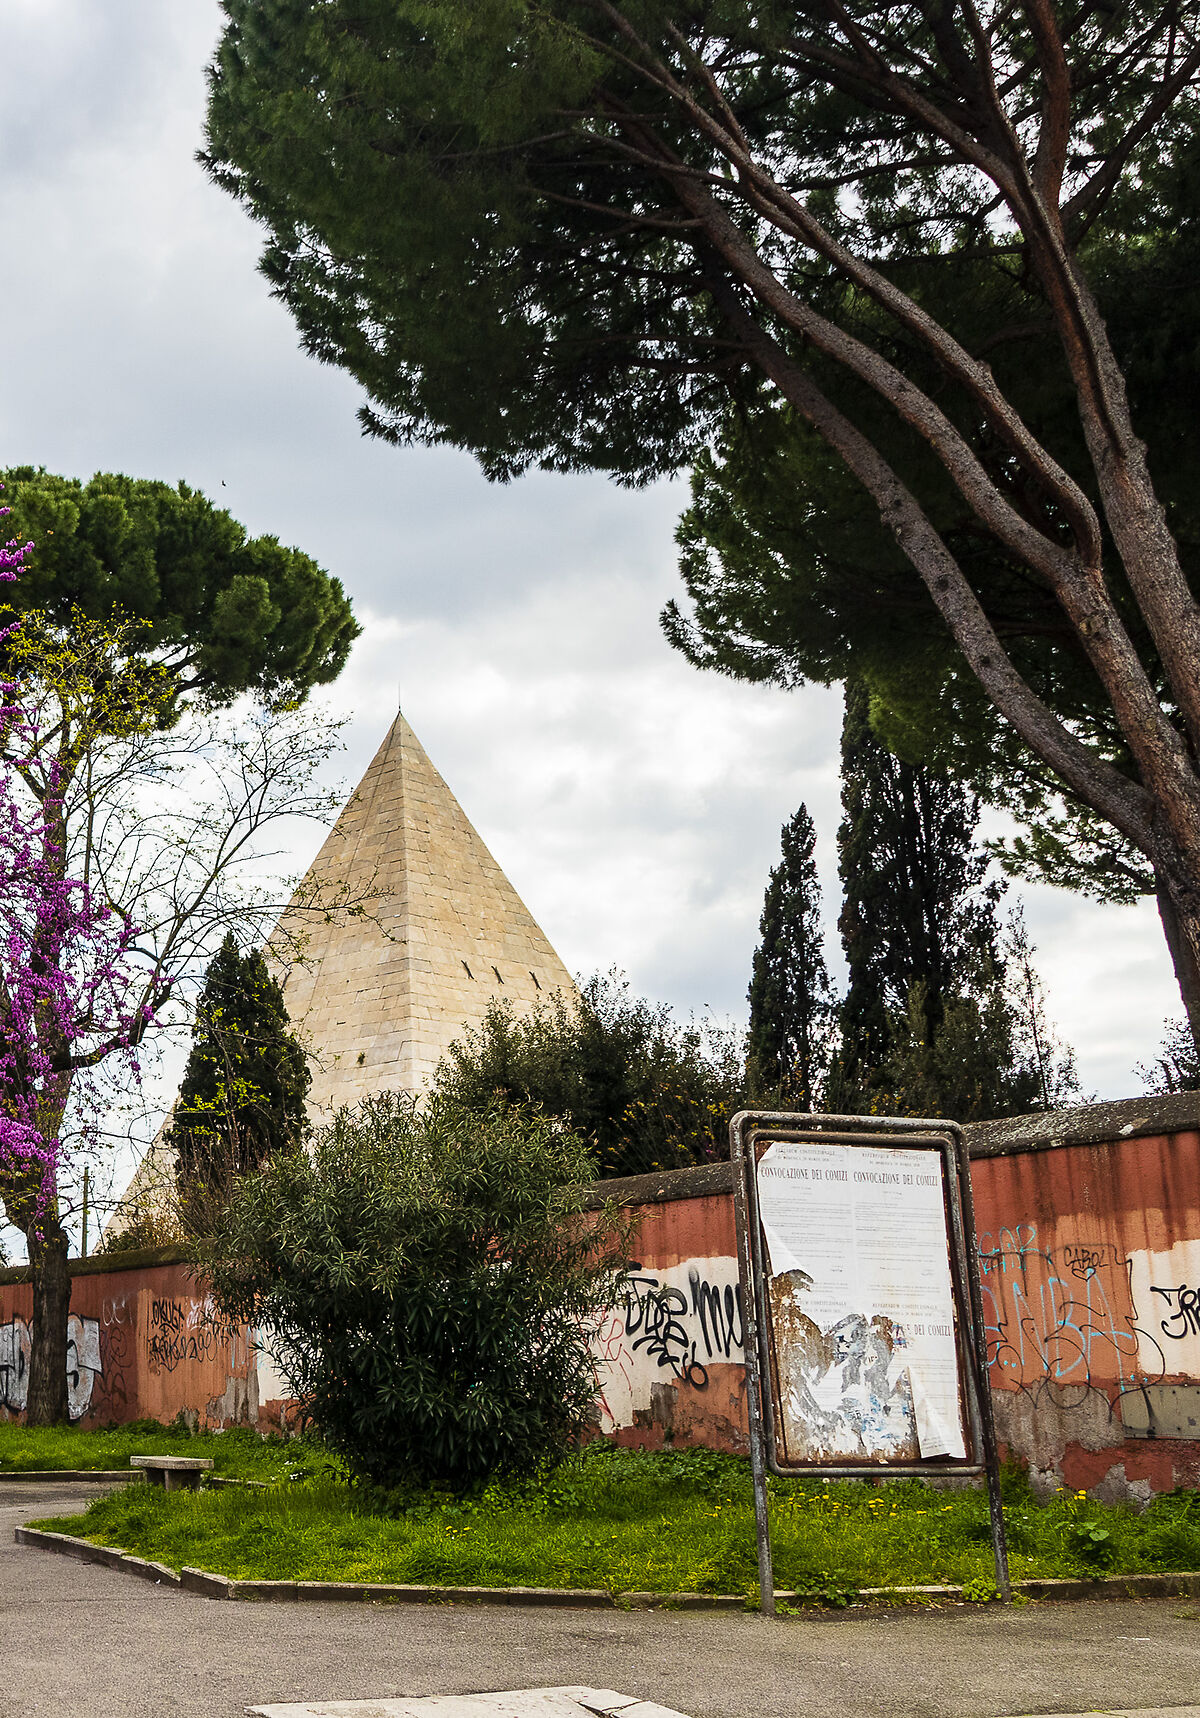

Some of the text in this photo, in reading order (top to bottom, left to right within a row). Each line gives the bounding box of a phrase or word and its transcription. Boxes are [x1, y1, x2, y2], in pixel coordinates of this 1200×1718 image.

[761, 1167, 848, 1181] CONVOCAZIONE DEI COMIZI
[853, 1171, 938, 1187] CONVOCAZIONE DEI COMIZI
[914, 1324, 925, 1336] DEI
[927, 1325, 951, 1337] COMIZI
